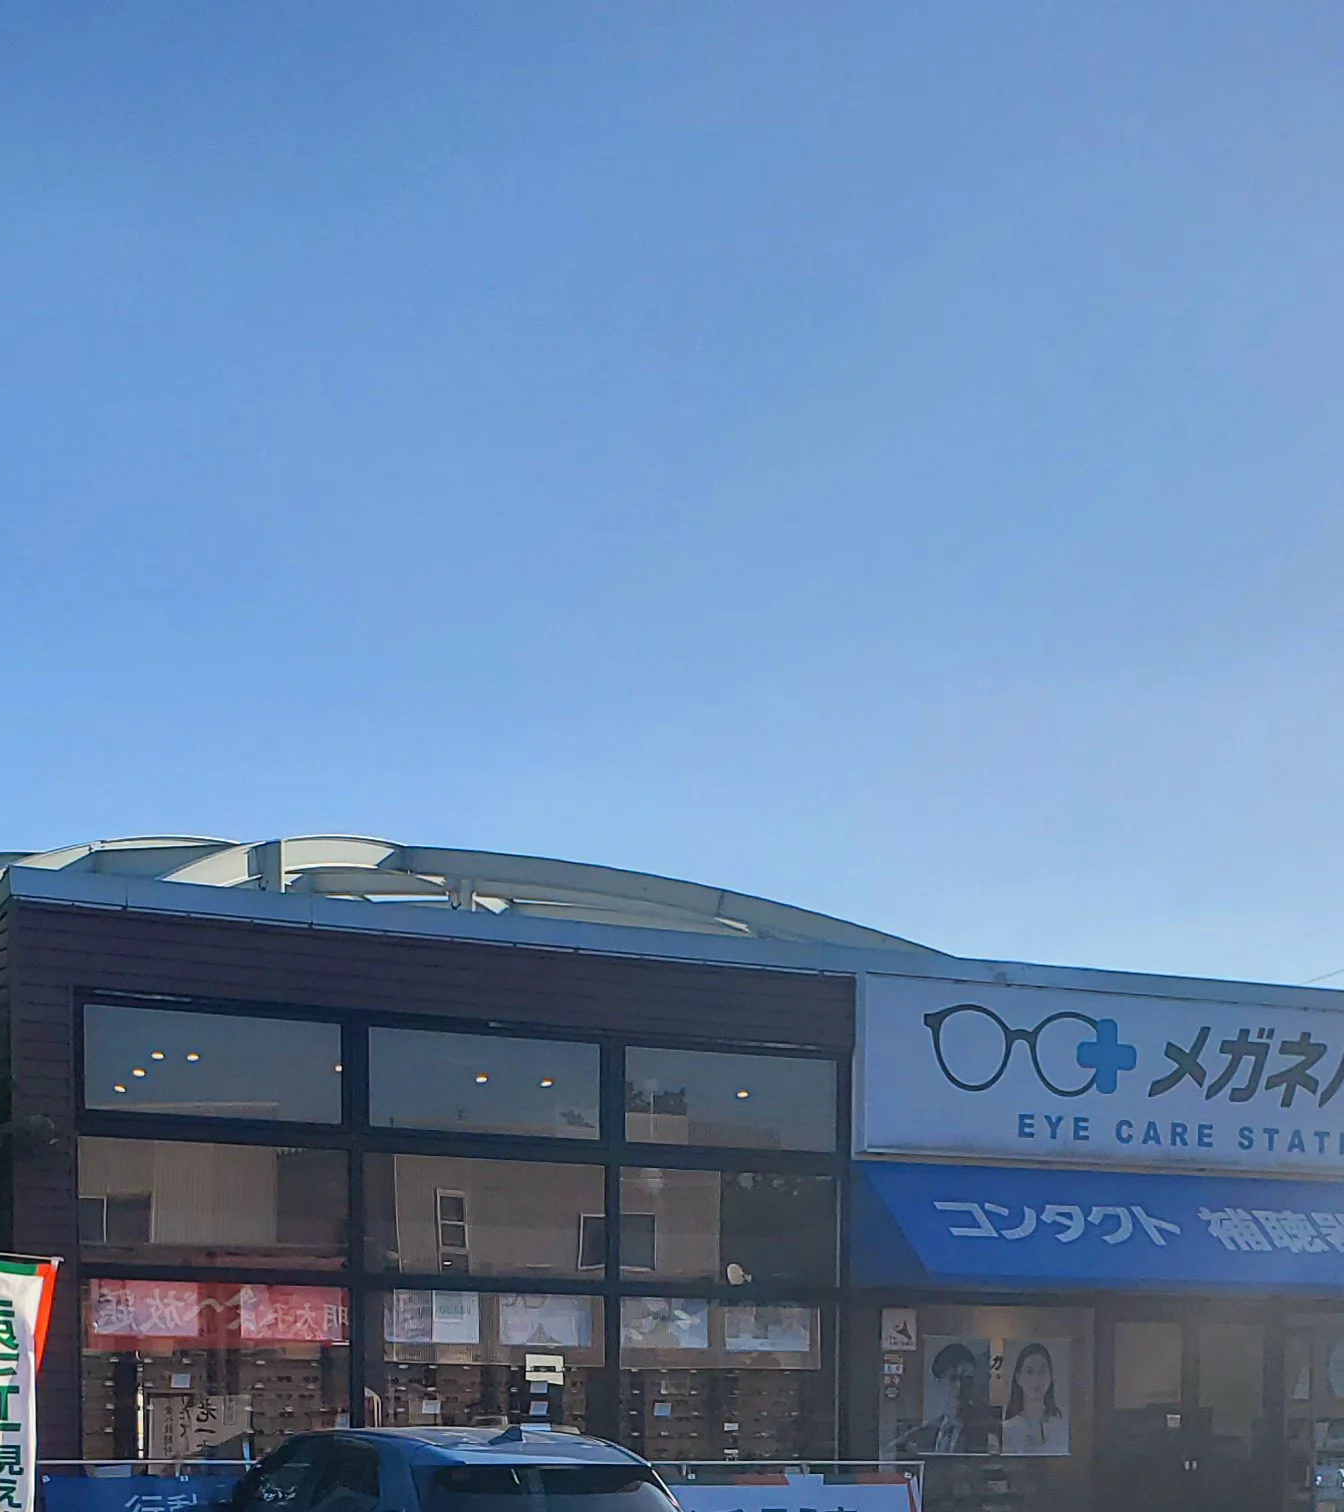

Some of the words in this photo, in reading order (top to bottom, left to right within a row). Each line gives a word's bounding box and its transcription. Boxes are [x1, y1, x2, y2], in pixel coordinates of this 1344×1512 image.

[1017, 1113, 1091, 1142] EYE
[1114, 1119, 1216, 1148] CARE
[932, 1200, 1182, 1247] コンタクト
